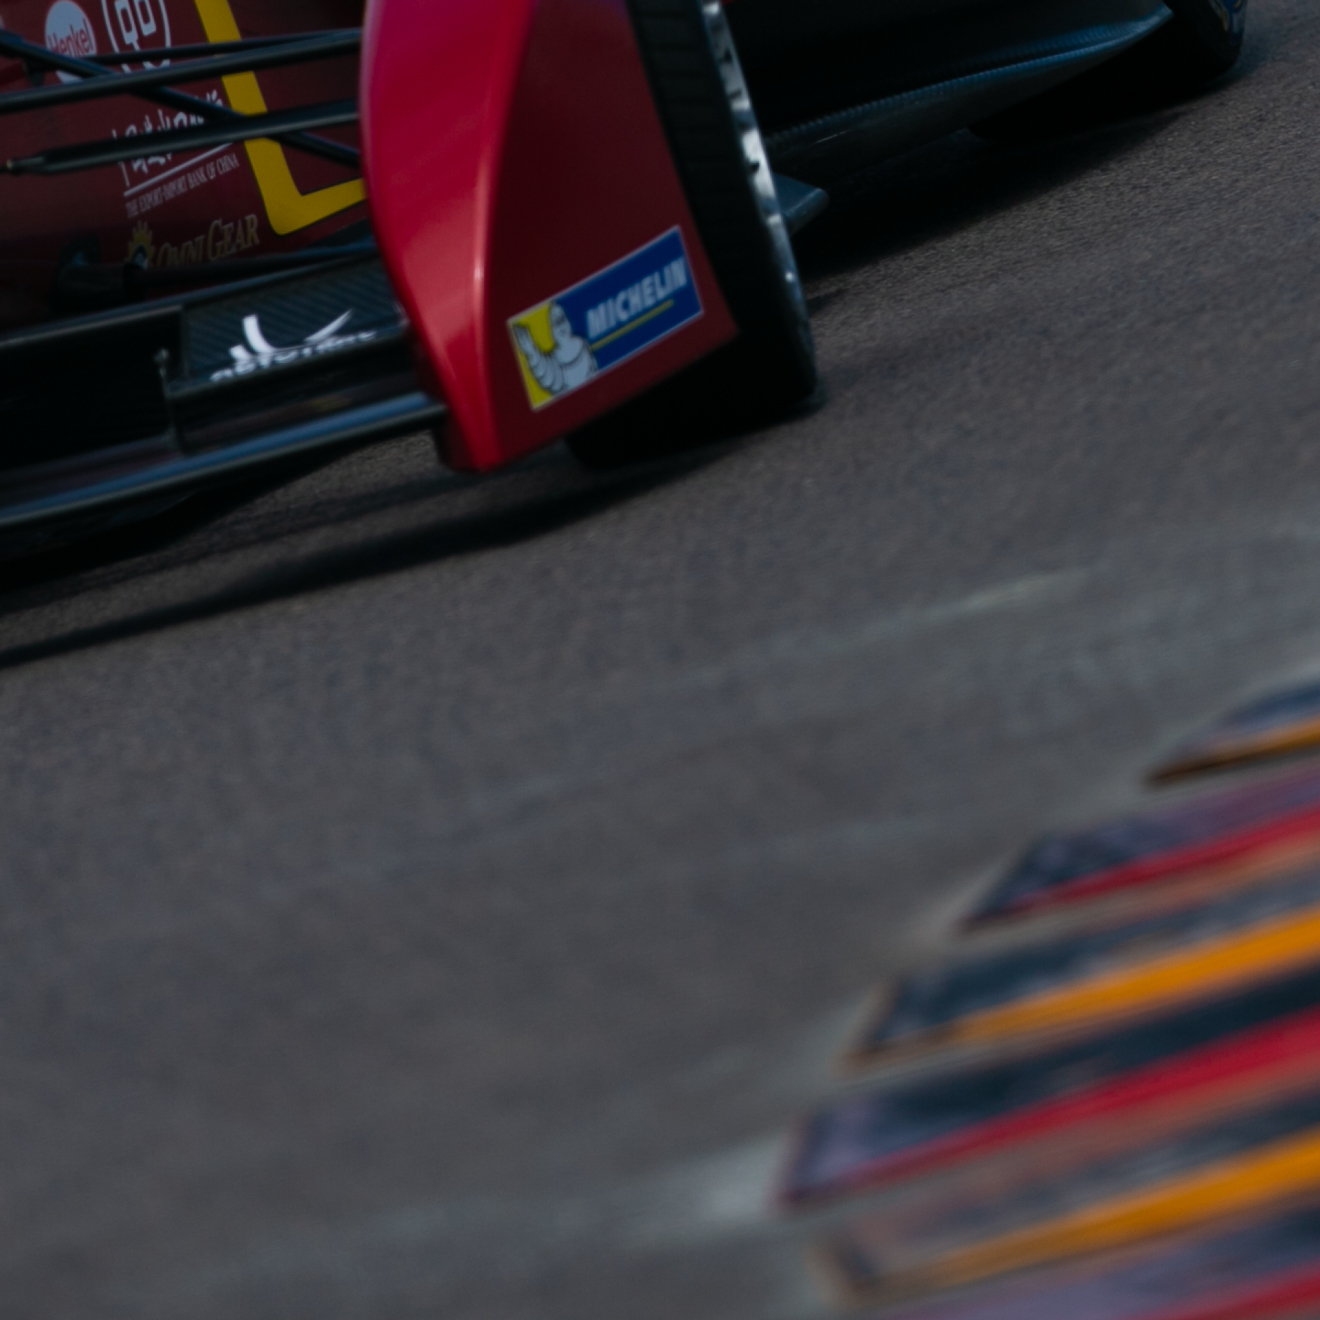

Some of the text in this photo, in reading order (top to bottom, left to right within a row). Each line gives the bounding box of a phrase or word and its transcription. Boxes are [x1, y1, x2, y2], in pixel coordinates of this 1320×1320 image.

[48, 17, 95, 59] Henkel
[139, 178, 187, 213] EXPORT-IMPORT
[188, 169, 208, 190] BANK
[207, 165, 217, 181] OF
[216, 152, 240, 177] CHINA
[586, 256, 687, 340] MICHELIN
